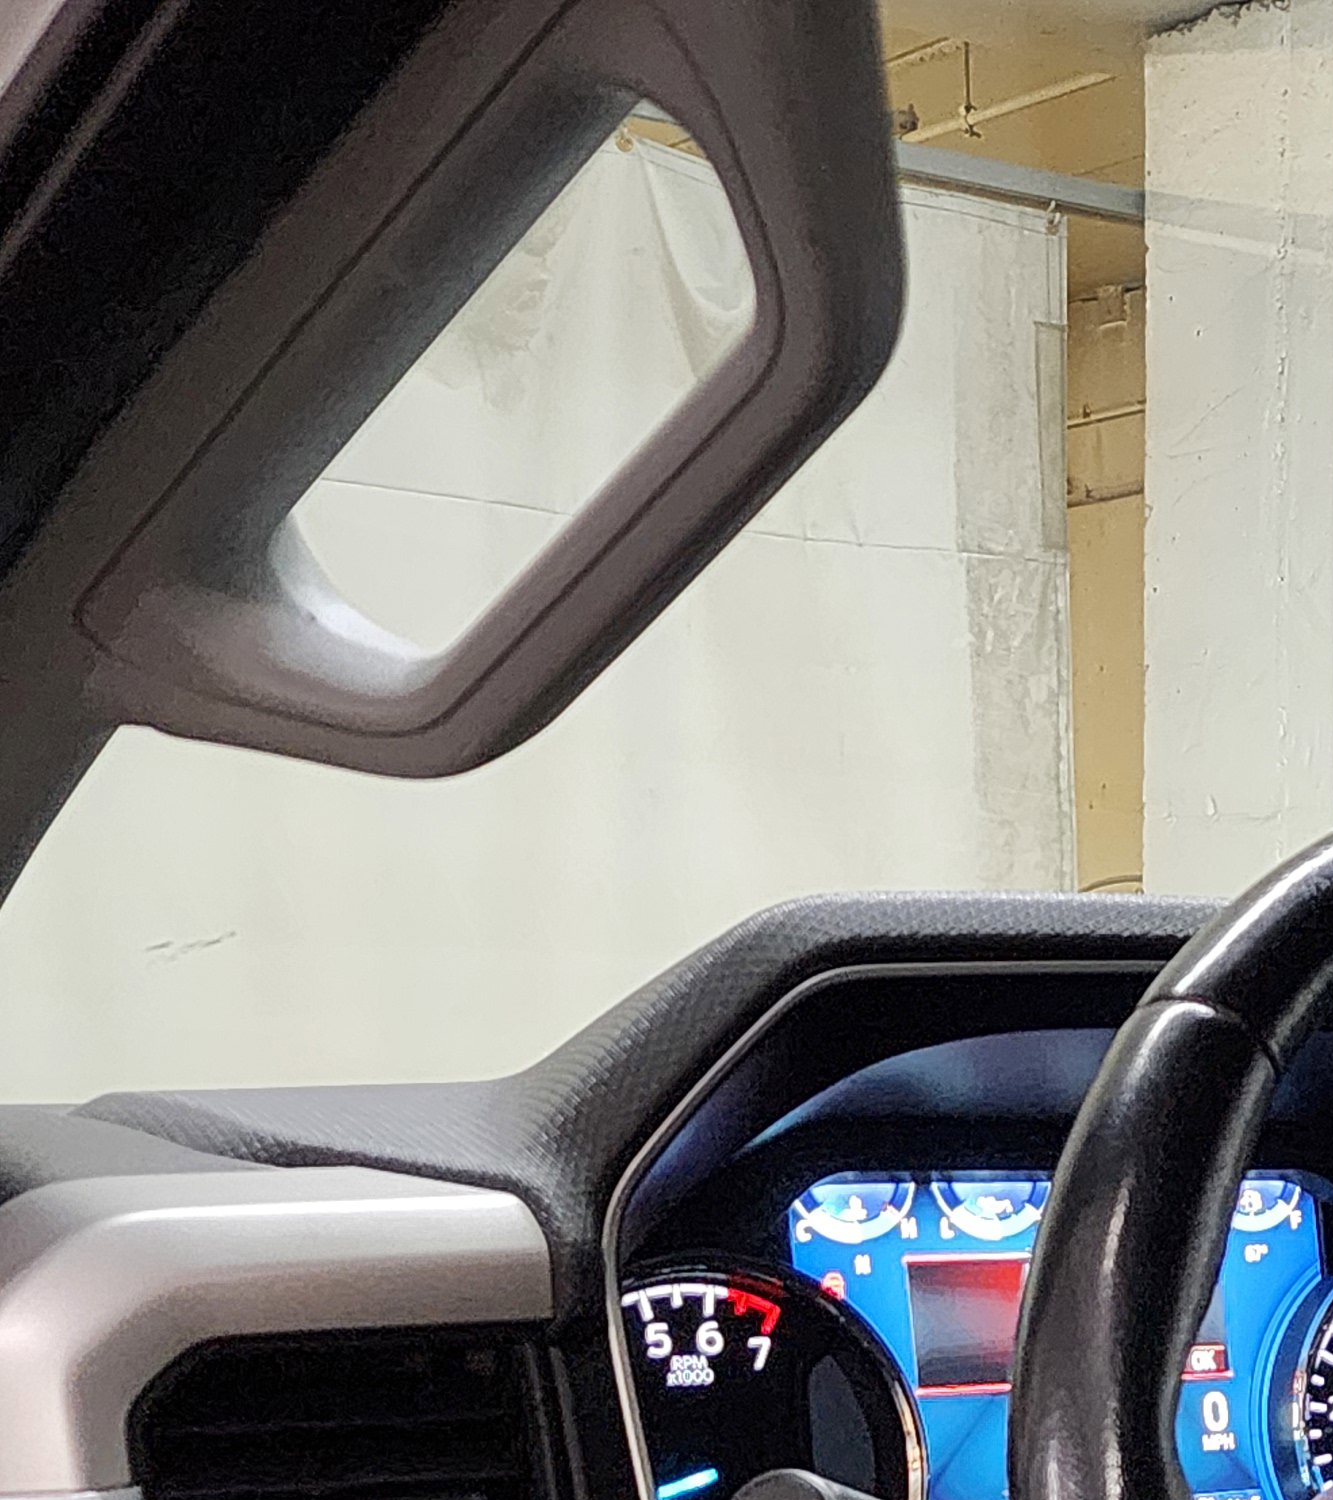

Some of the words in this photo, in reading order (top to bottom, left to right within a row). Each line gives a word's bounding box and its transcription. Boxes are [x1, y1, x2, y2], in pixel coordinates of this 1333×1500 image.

[644, 1322, 672, 1359] 5
[696, 1320, 724, 1357] 6
[747, 1336, 771, 1371] 7
[670, 1355, 709, 1371] RPM
[1203, 1390, 1229, 1432] 0
[1202, 1432, 1236, 1451] MPH
